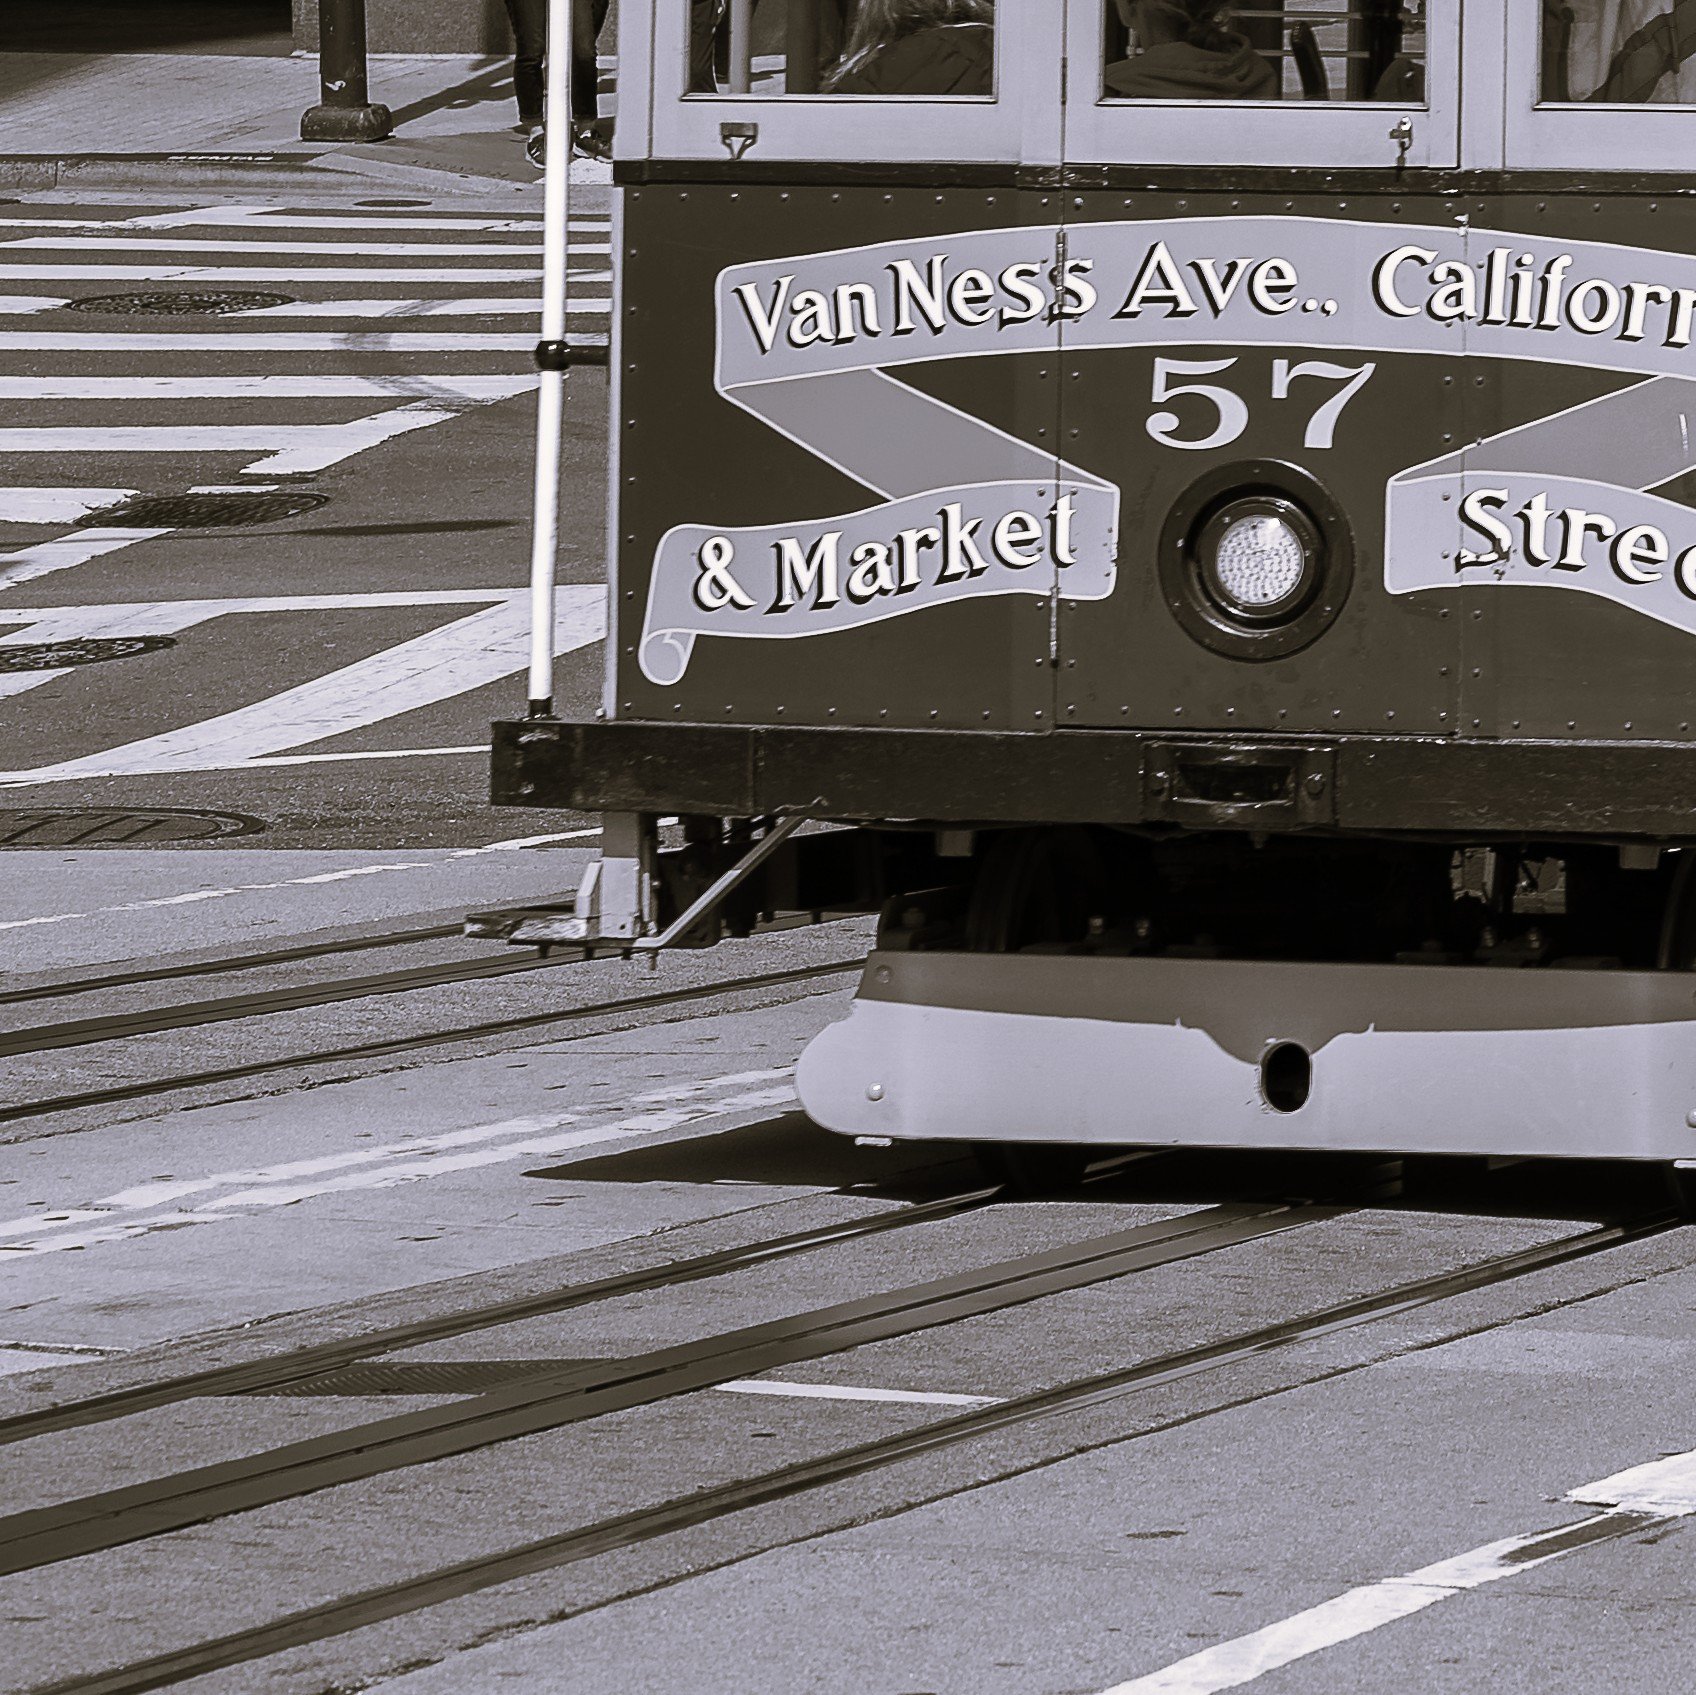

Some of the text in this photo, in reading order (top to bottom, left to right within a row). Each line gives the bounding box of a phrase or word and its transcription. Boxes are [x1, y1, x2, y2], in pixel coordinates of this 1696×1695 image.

[731, 274, 883, 355] Van
[885, 253, 1098, 335] Ness
[1145, 356, 1377, 450] 57
[692, 493, 1078, 617] & Market
